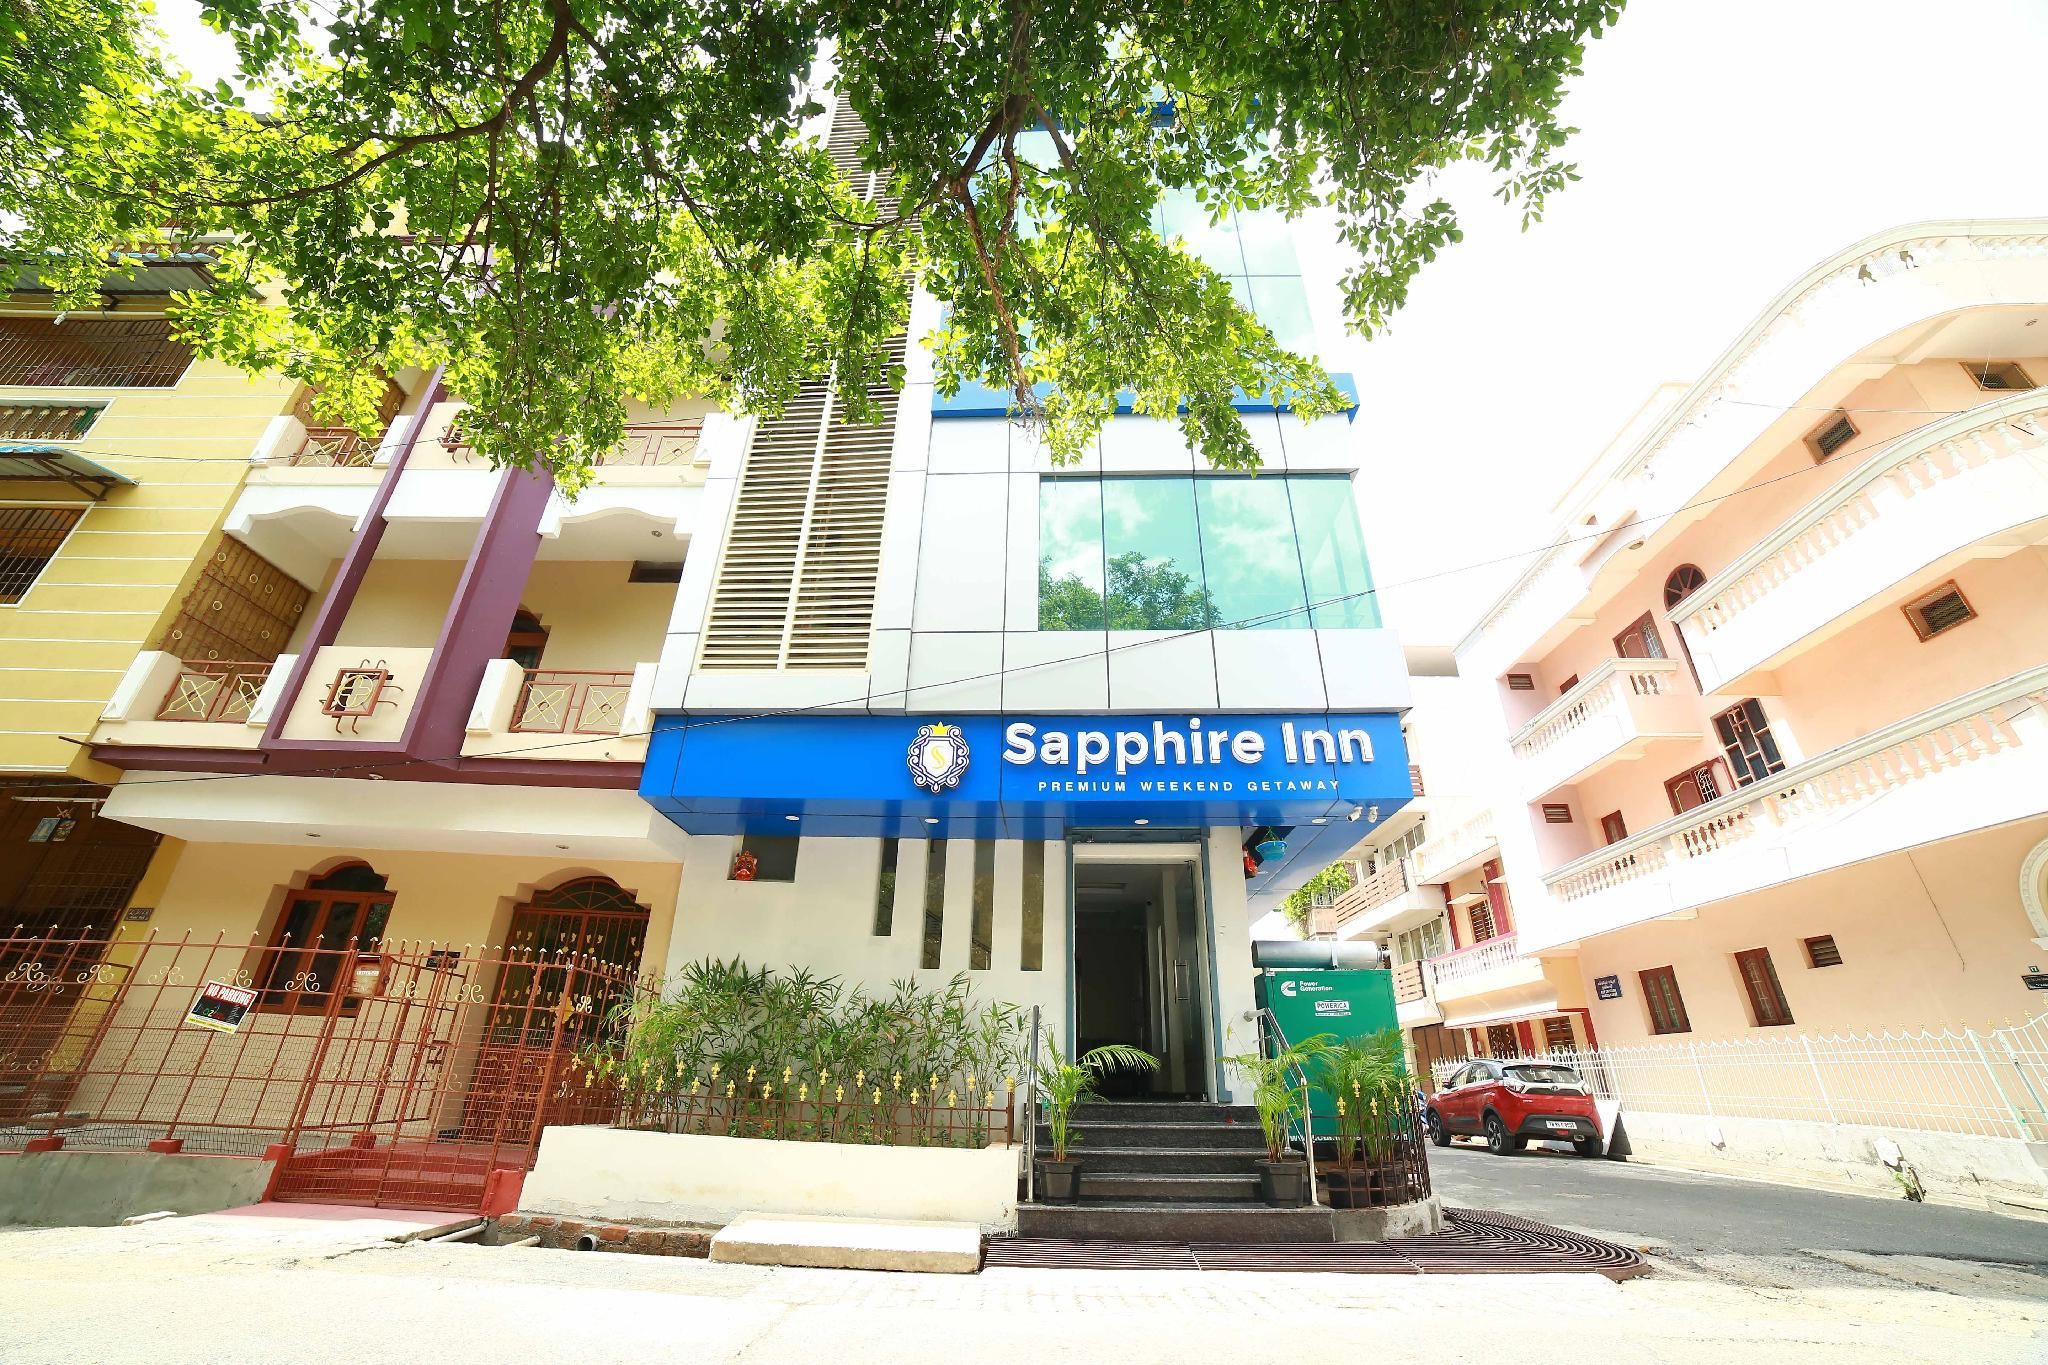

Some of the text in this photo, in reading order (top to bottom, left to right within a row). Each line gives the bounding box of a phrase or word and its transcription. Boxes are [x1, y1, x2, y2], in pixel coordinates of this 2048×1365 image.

[1002, 718, 1375, 775] Sapphire Inn
[1038, 780, 1340, 792] PREMIUM WEEKEND GETAWAY
[205, 983, 252, 1006] NO PARKING
